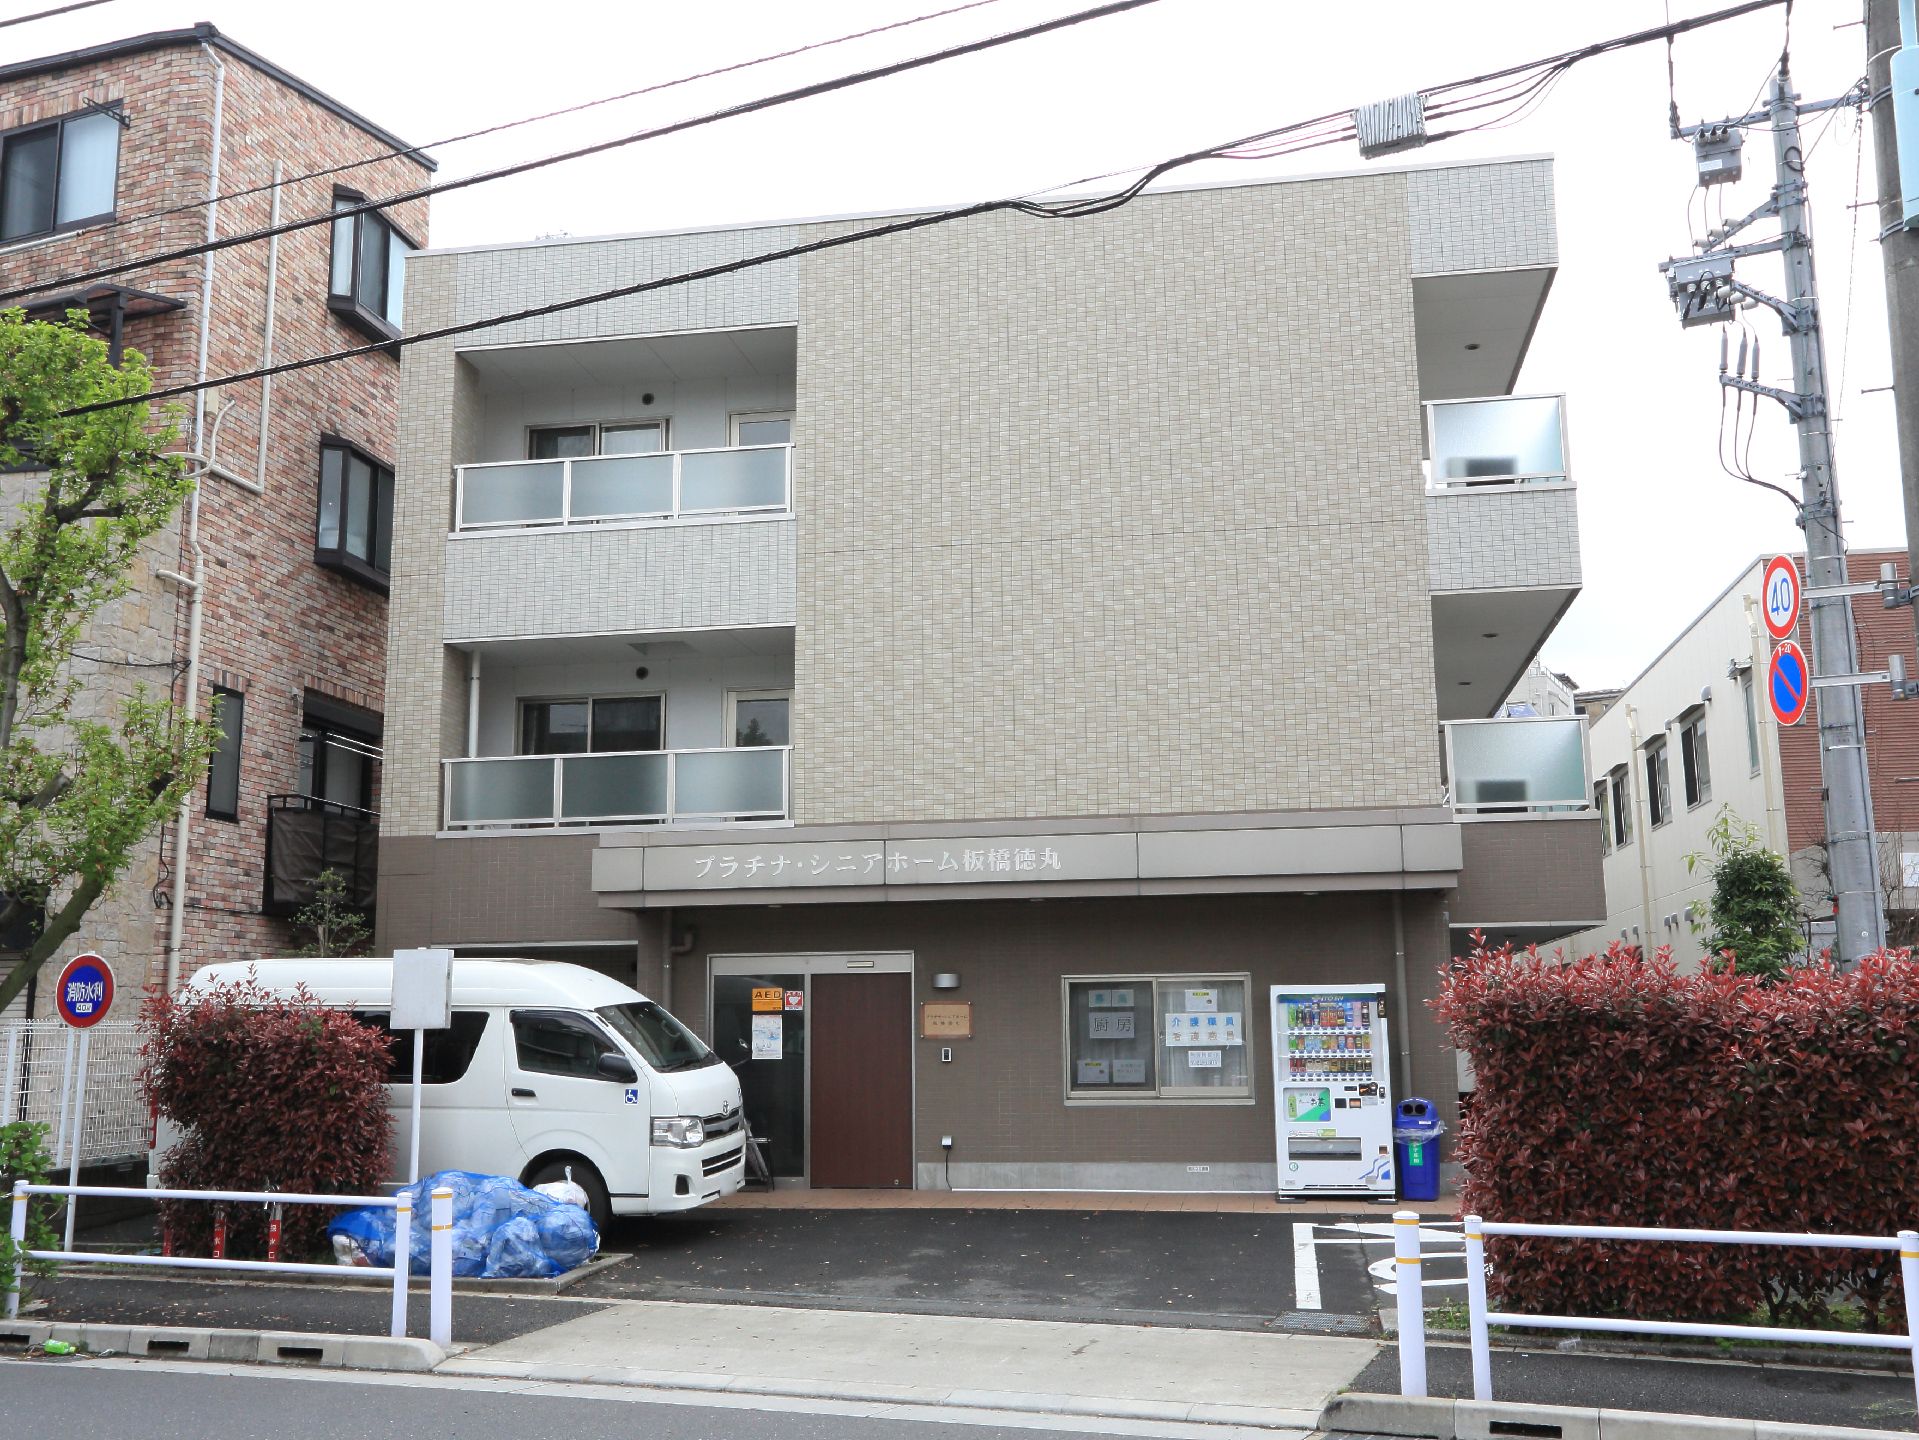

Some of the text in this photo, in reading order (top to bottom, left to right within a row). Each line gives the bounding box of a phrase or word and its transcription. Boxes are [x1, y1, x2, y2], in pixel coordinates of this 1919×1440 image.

[1770, 577, 1791, 616] 40
[66, 980, 104, 1002] 消防水利
[754, 991, 781, 999] AED
